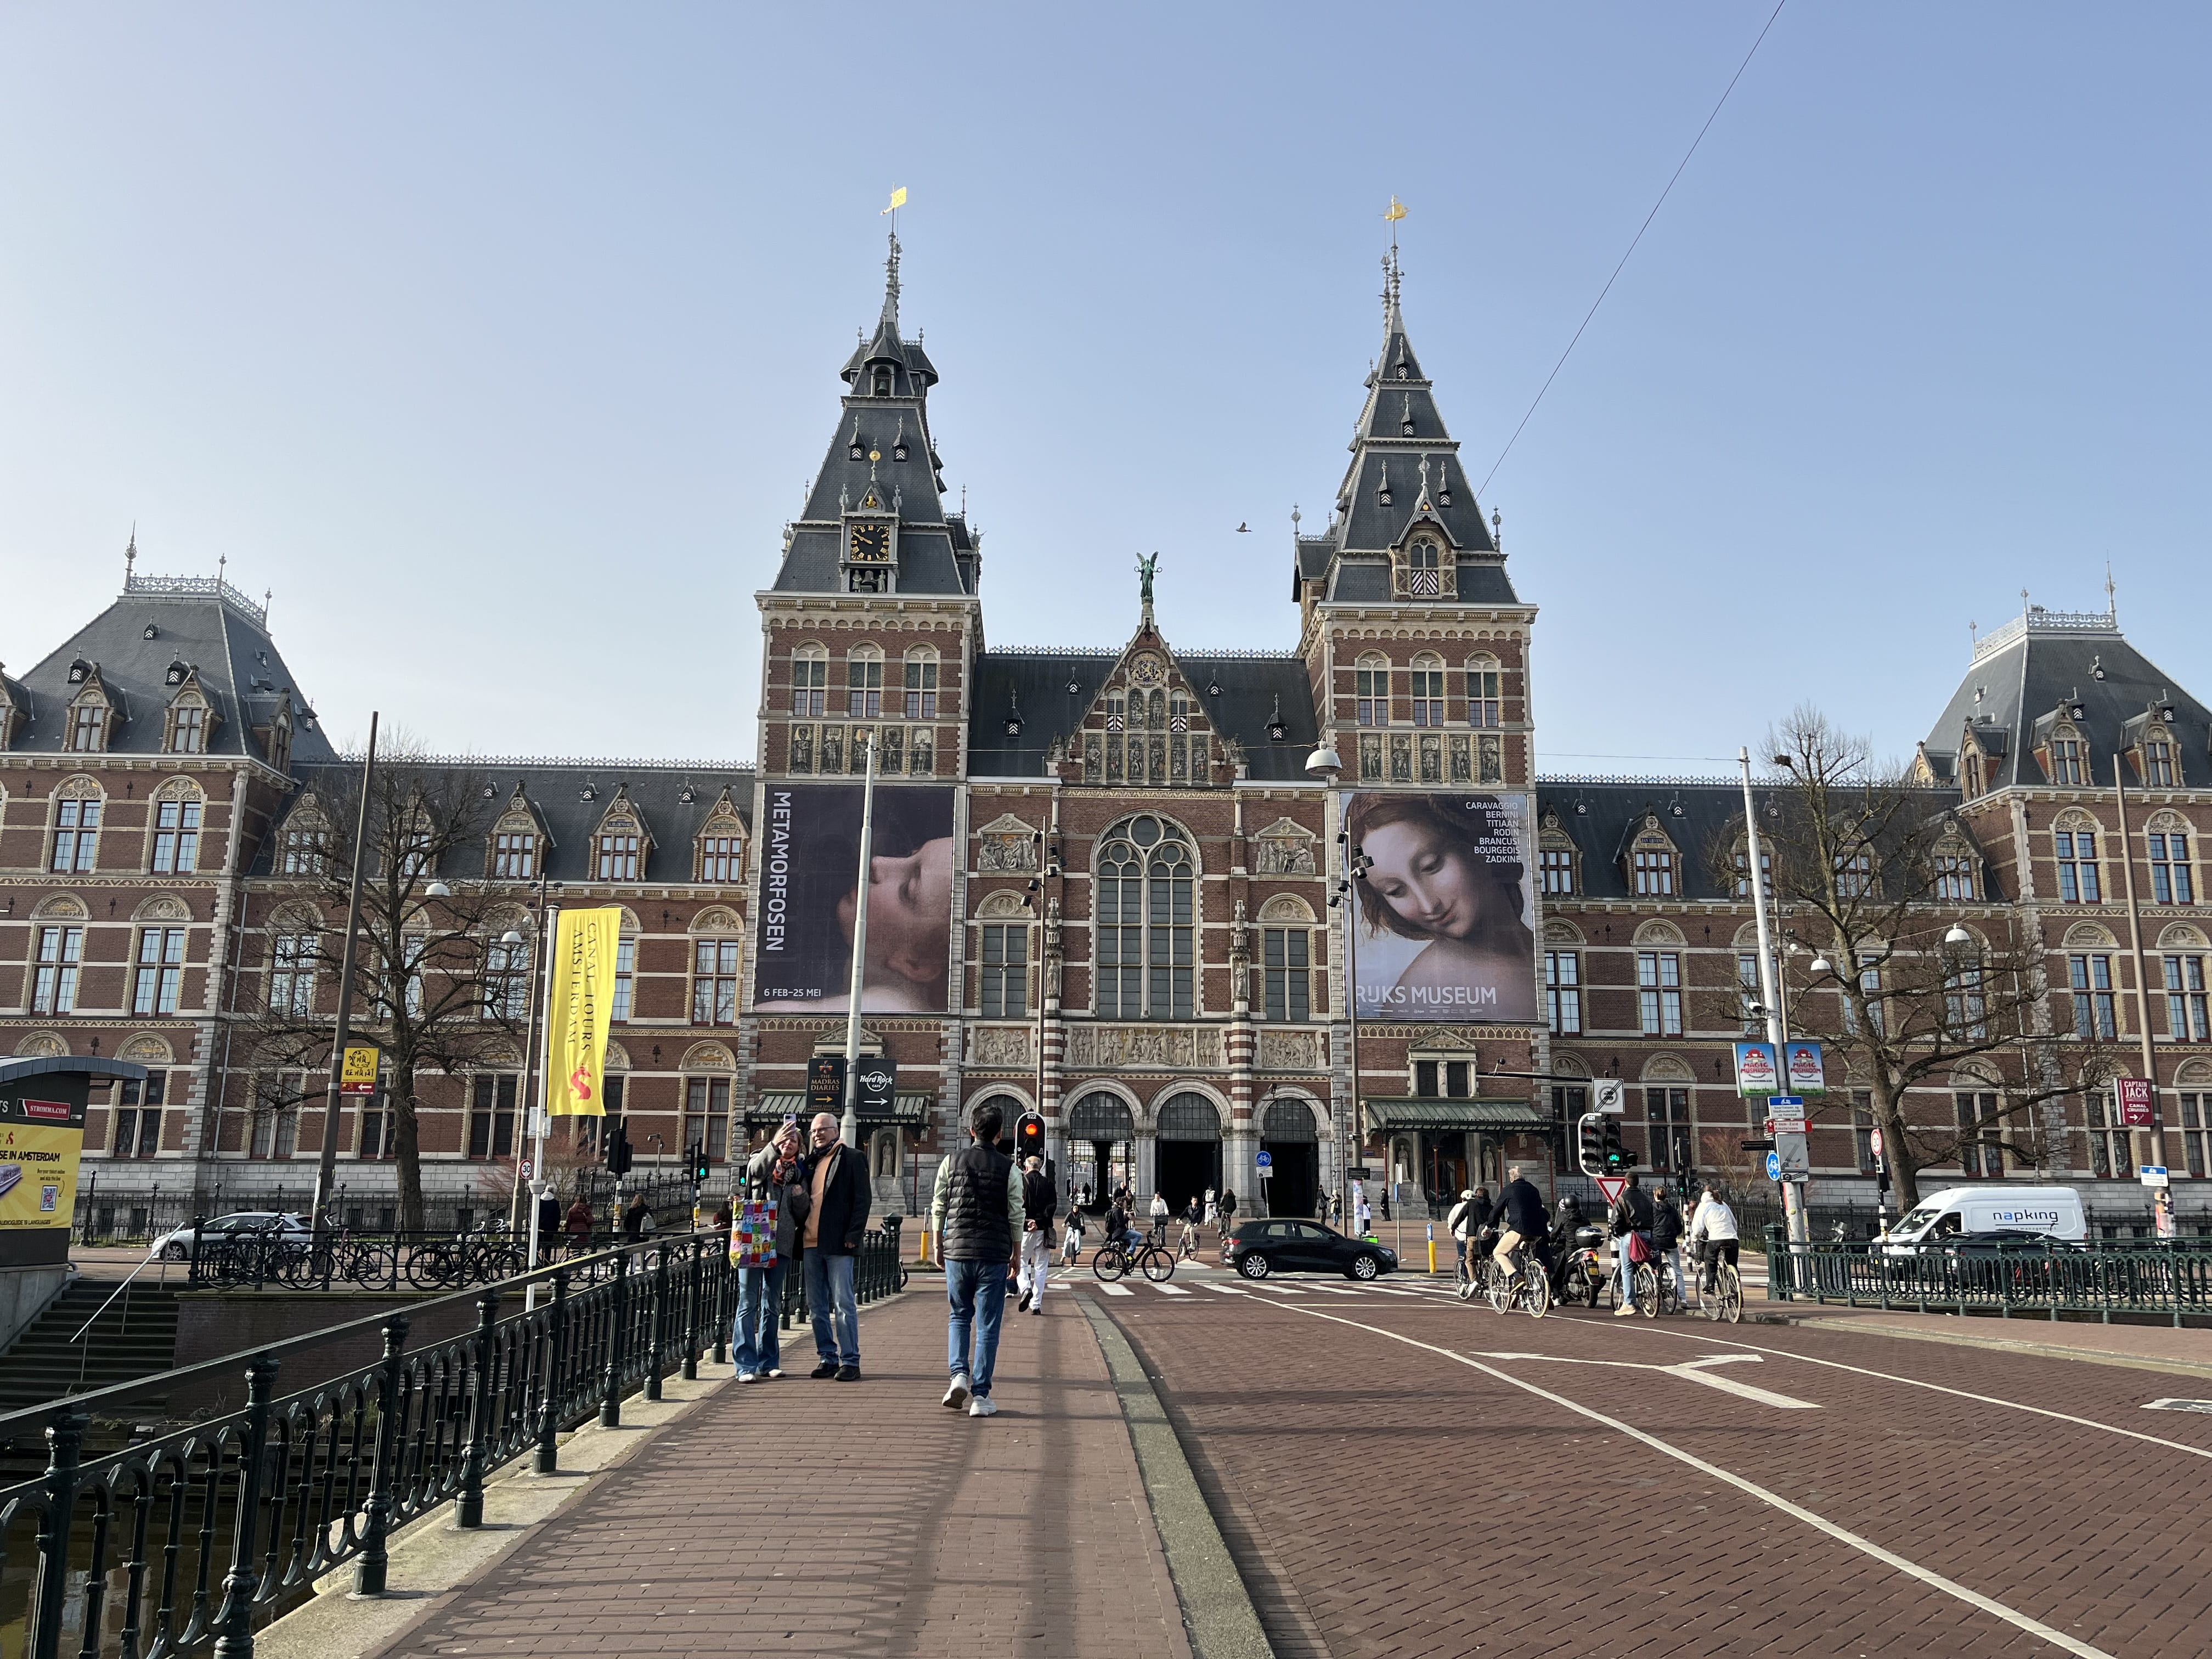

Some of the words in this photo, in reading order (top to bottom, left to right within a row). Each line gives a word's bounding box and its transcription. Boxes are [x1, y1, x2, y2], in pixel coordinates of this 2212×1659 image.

[1465, 802, 1518, 810] CARAVAGGIO
[766, 792, 791, 951] METAMORFOSEN
[586, 922, 596, 982] CANAL
[568, 929, 583, 1043] AMSTERDAM
[1356, 985, 1406, 1004] RIJKS
[1411, 986, 1497, 1005] MUSEUM
[581, 993, 594, 1051] TOURS
[860, 1075, 877, 1083] Hard
[877, 1075, 893, 1085] Rock
[2125, 1087, 2148, 1098] JACK
[30, 1105, 67, 1114] STROMMA.COM
[1873, 1138, 1880, 1147] 30
[9, 1150, 16, 1160] IN
[18, 1151, 60, 1161] AMSTERDAM
[522, 1165, 531, 1173] 30
[1993, 1209, 2058, 1223] napking
